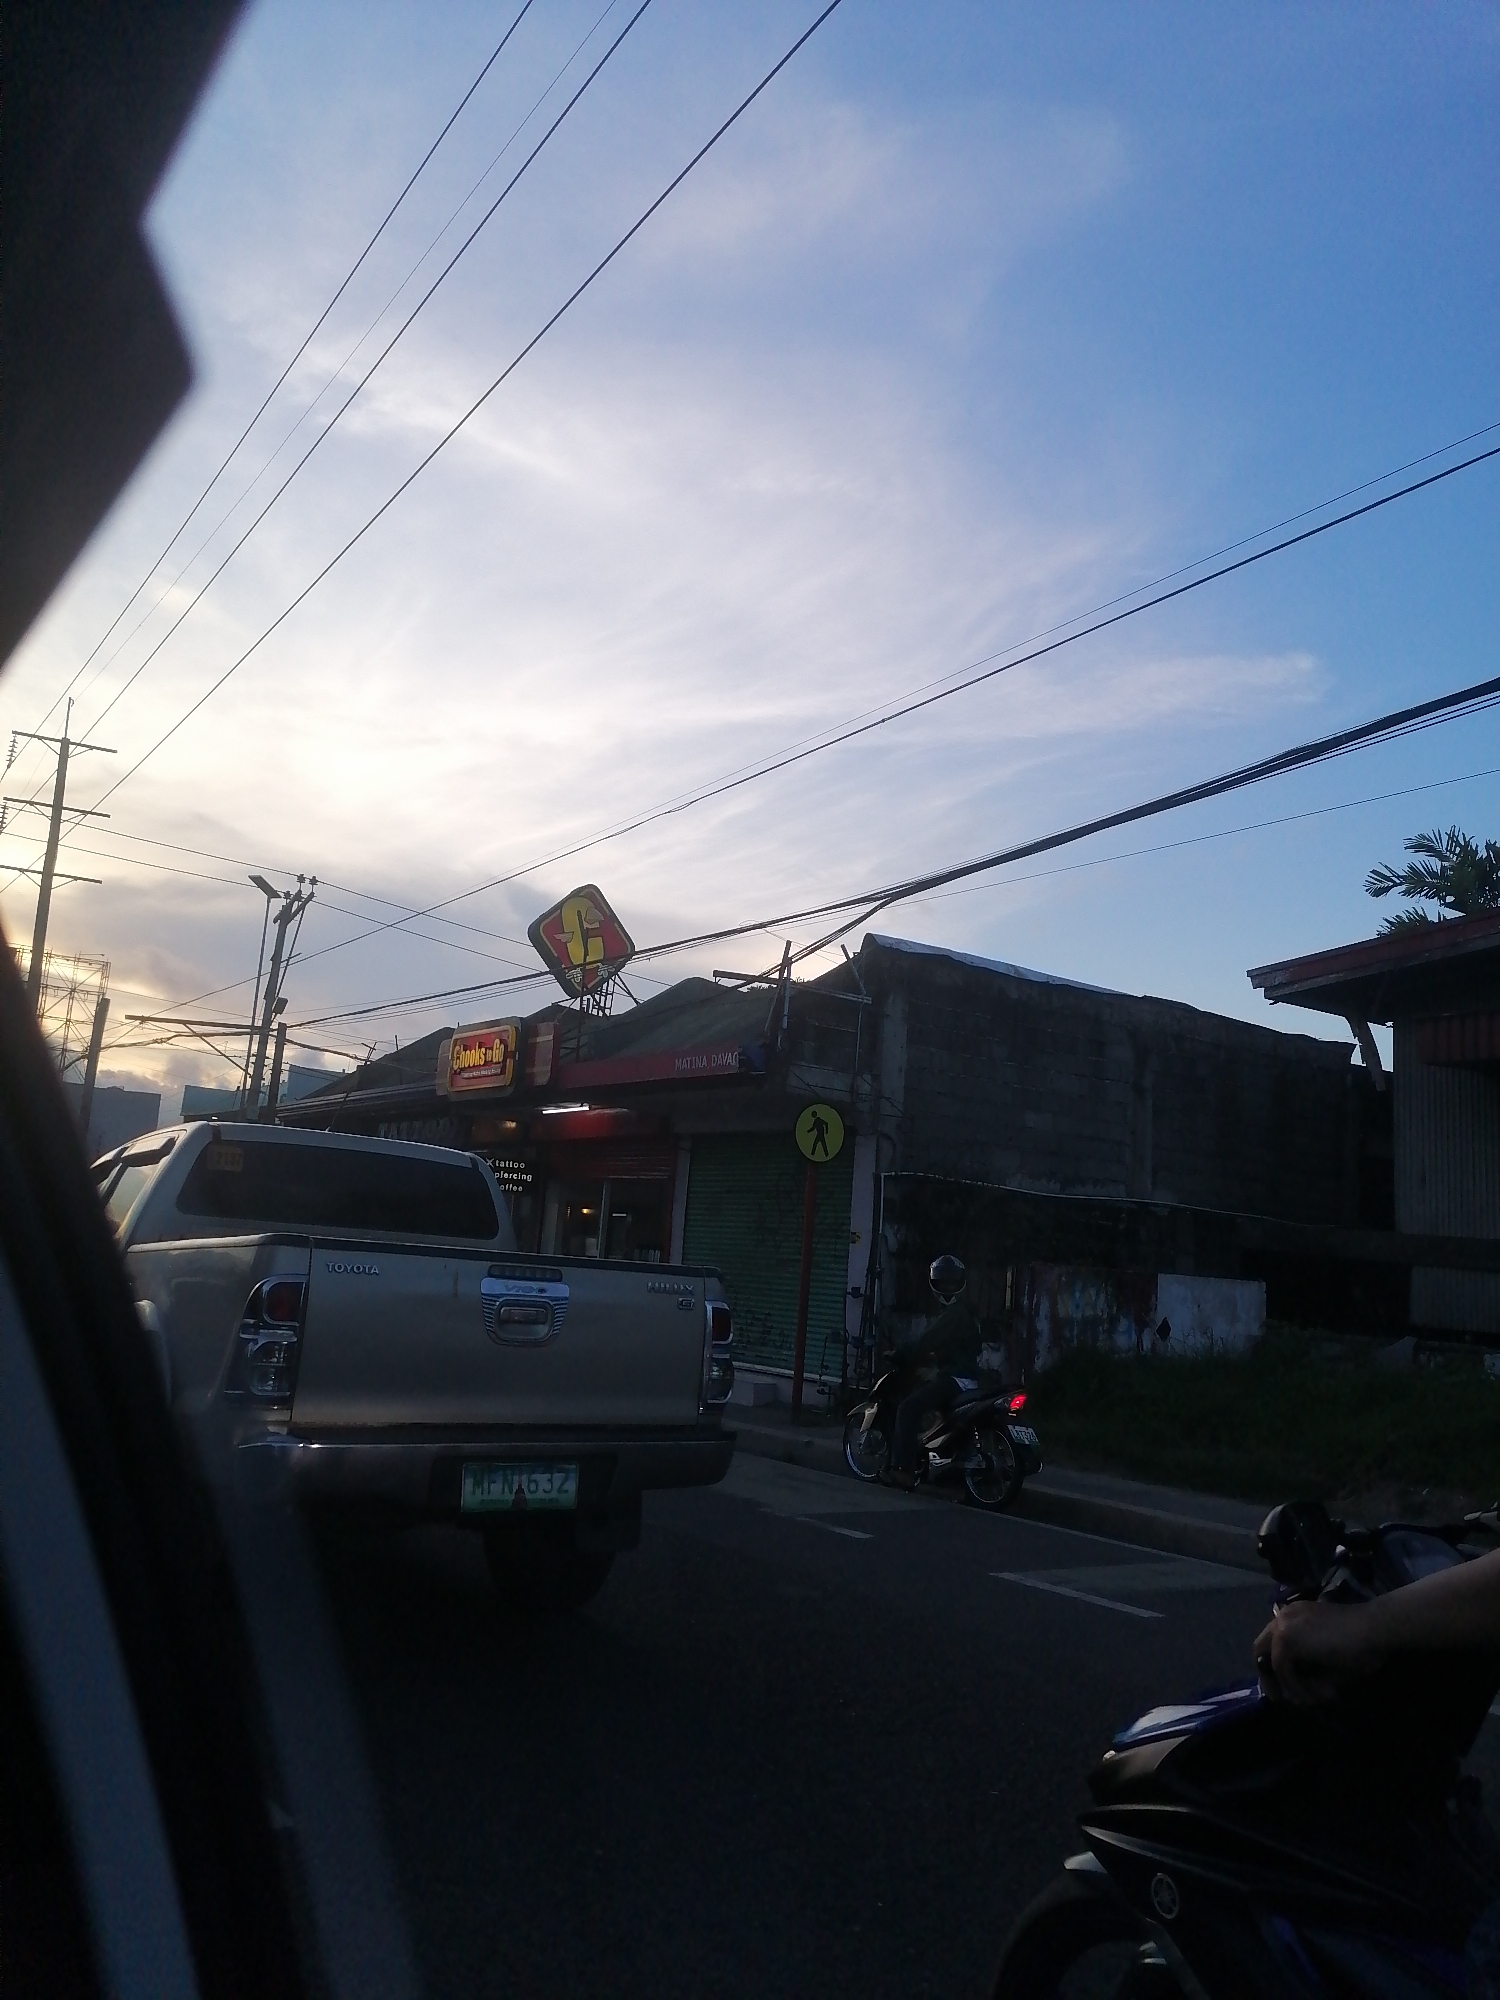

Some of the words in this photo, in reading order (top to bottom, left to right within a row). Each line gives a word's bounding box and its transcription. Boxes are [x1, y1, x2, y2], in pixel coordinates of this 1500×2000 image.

[453, 1042, 485, 1071] Chooks
[493, 1038, 504, 1063] Go
[711, 1051, 739, 1067] DAVAO
[495, 1160, 525, 1169] tattoo
[494, 1171, 532, 1182] piercing
[499, 1183, 523, 1192] offee
[327, 1262, 379, 1275] TOYOTA
[527, 1471, 569, 1495] 632
